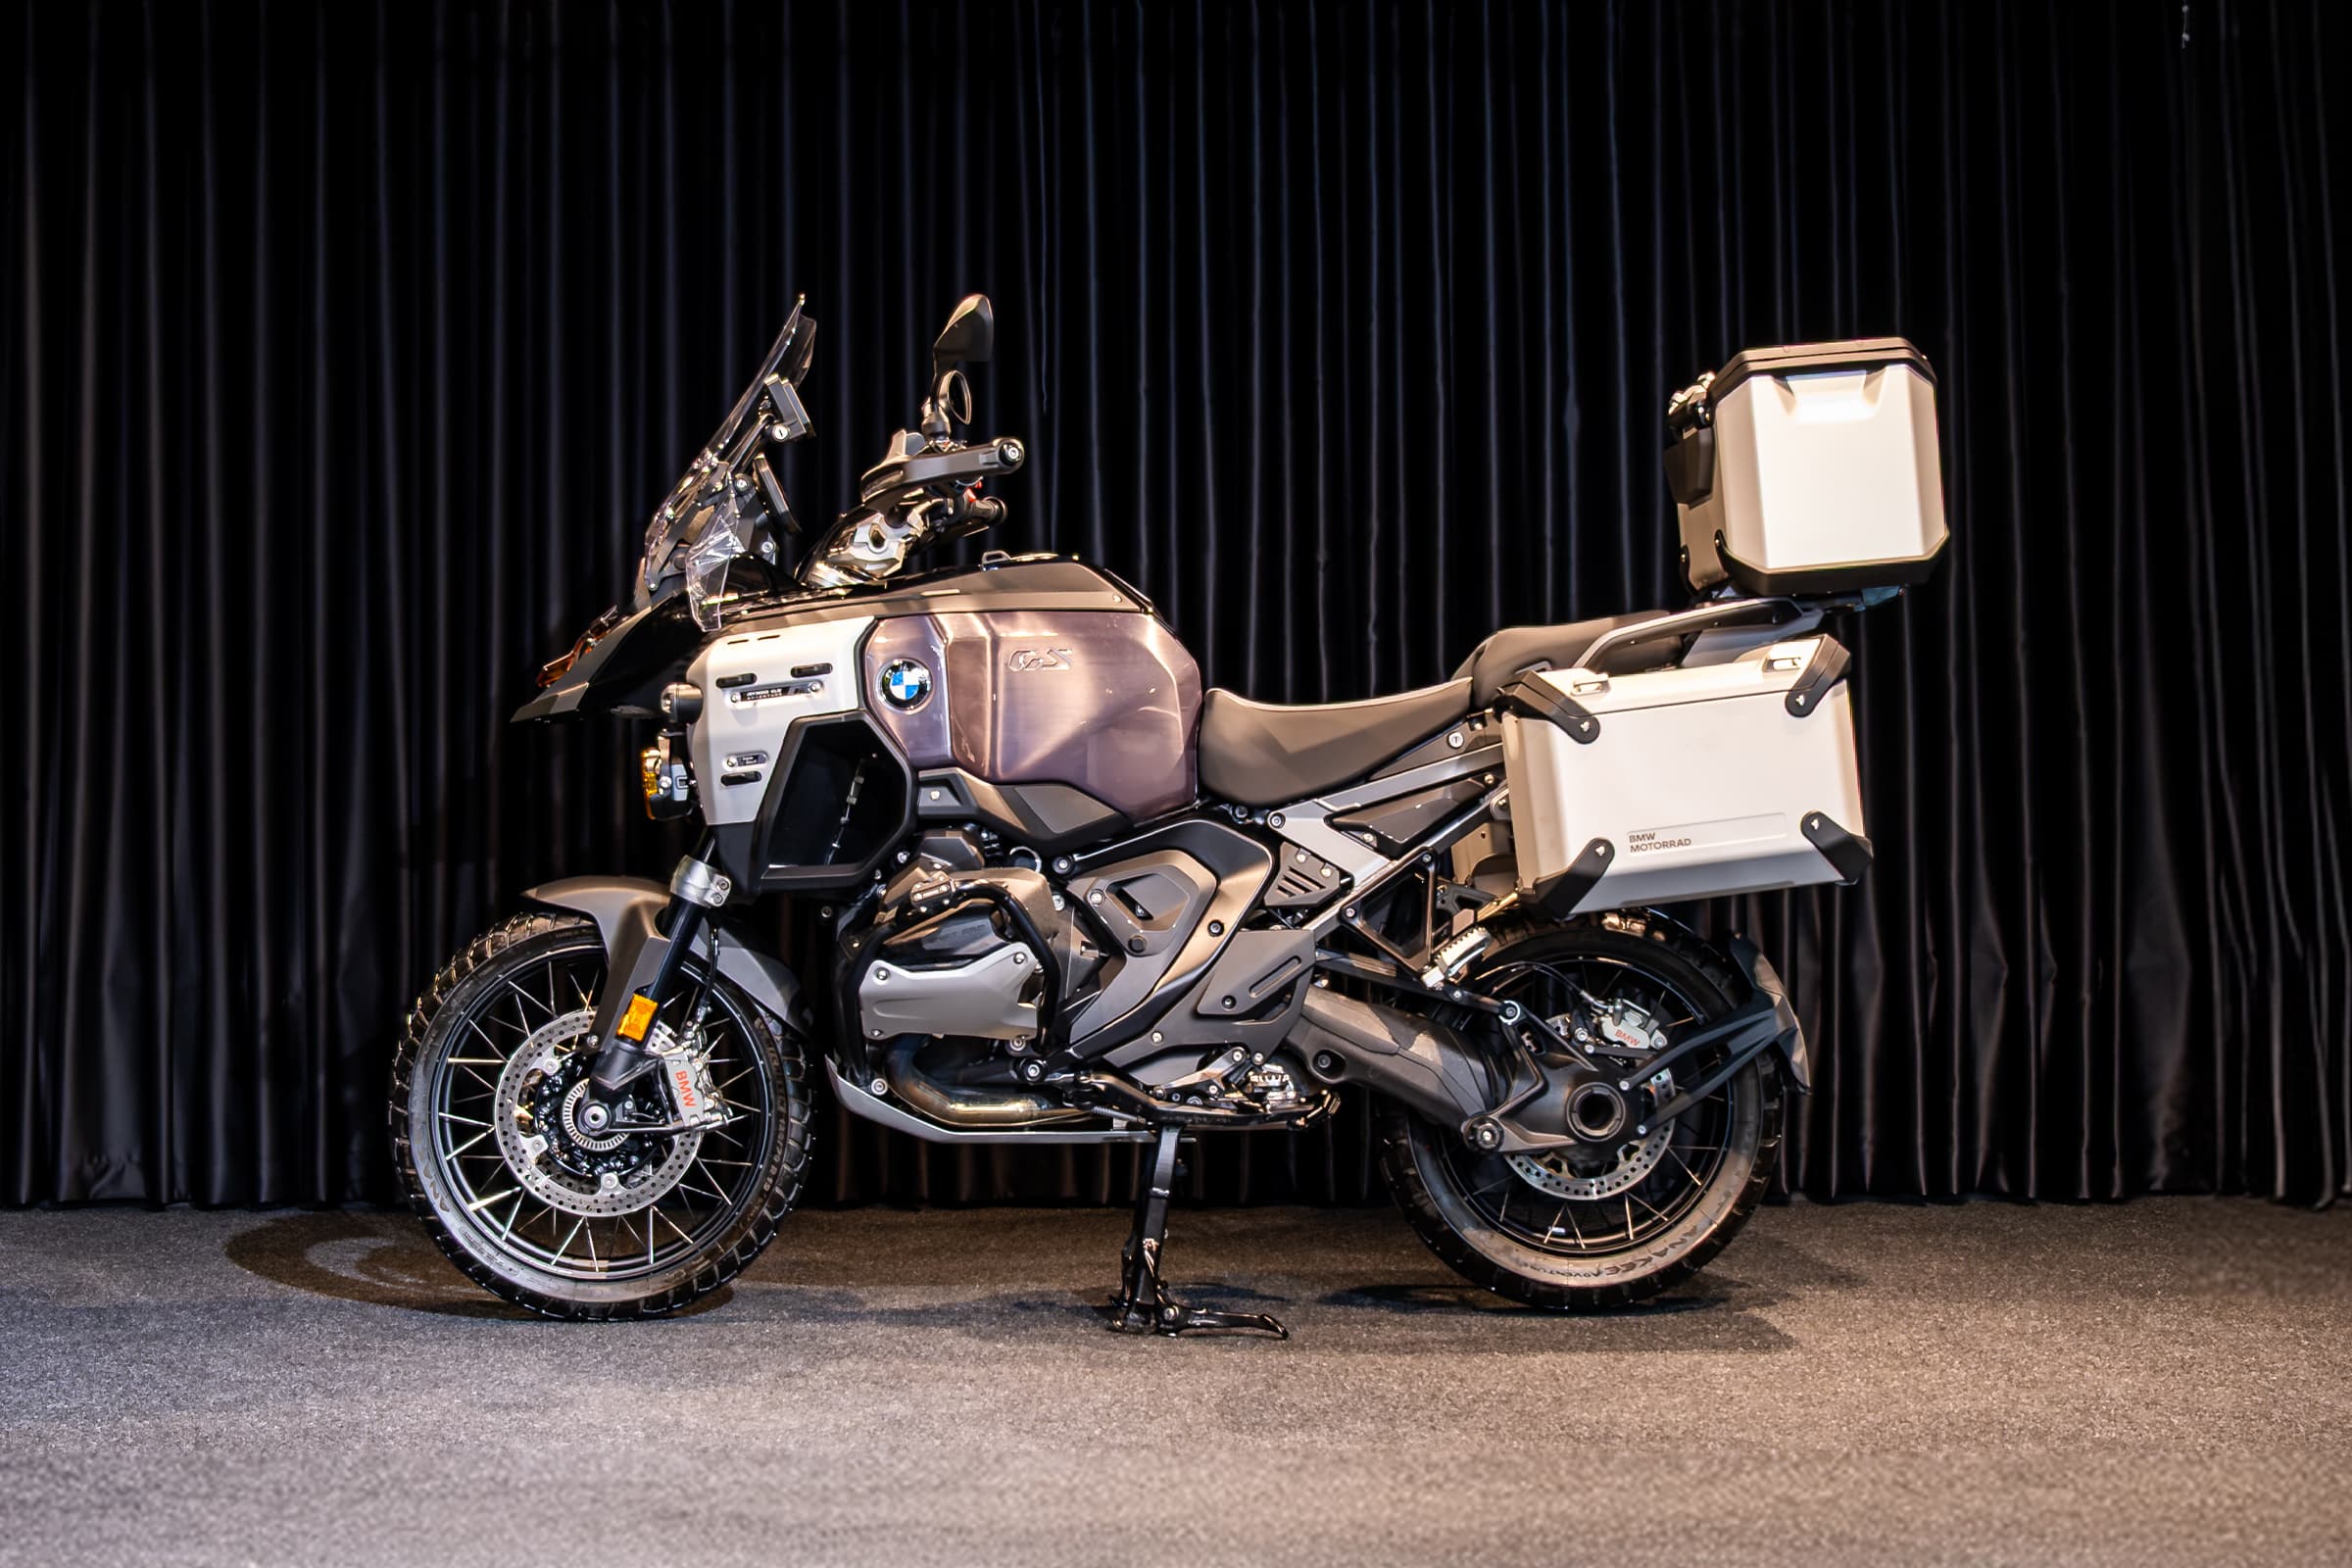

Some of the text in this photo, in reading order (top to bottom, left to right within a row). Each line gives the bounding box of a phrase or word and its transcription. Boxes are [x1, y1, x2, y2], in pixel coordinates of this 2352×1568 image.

[1008, 648, 1073, 672] GS
[1629, 832, 1655, 843] BMW
[1630, 838, 1691, 853] MOTORRAD
[1615, 1029, 1641, 1046] BMW
[675, 1070, 697, 1106] BMW
[1605, 1225, 1697, 1276] ANAKEE
